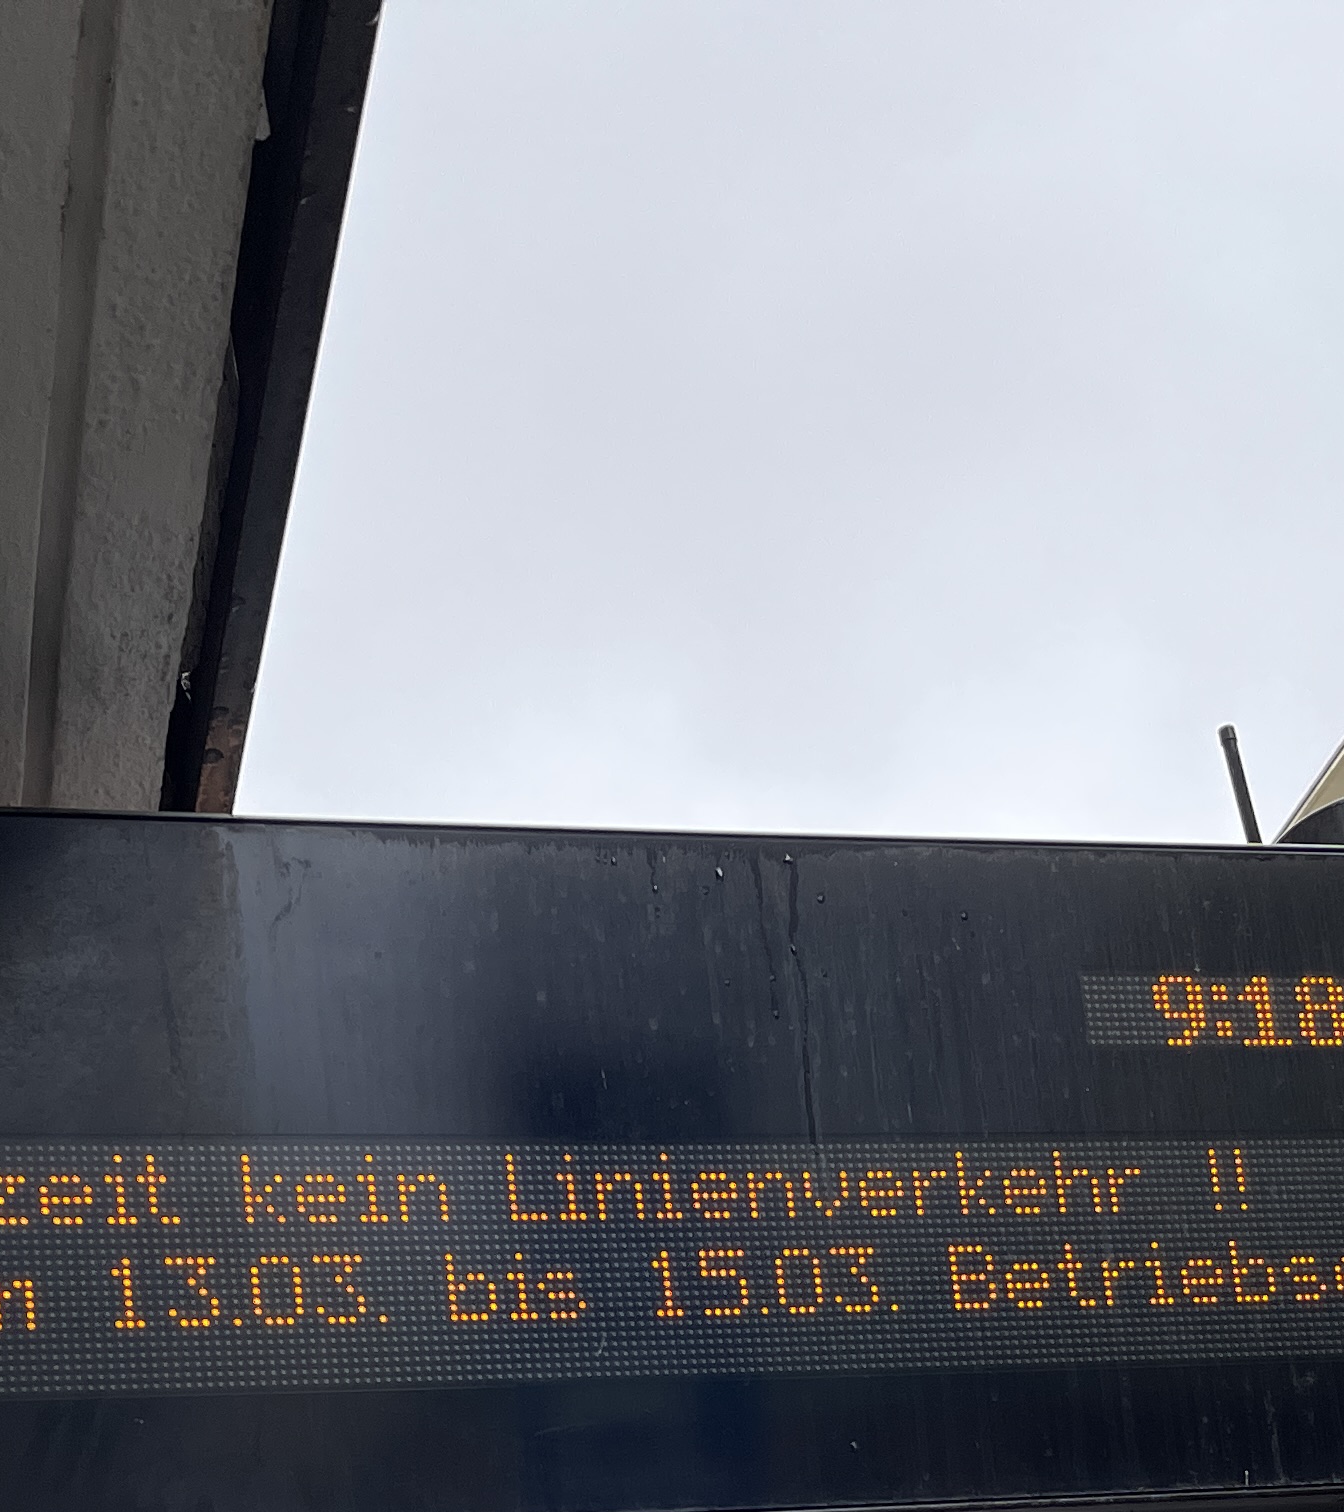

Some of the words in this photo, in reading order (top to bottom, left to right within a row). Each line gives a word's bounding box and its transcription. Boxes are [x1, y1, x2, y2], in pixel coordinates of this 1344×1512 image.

[240, 1154, 449, 1224] kein
[504, 1151, 1141, 1221] Linienverkehr
[1208, 1148, 1248, 1211] !!
[111, 1254, 388, 1329] 13.03.
[444, 1252, 587, 1322] bis
[651, 1246, 899, 1317] 15.03.
